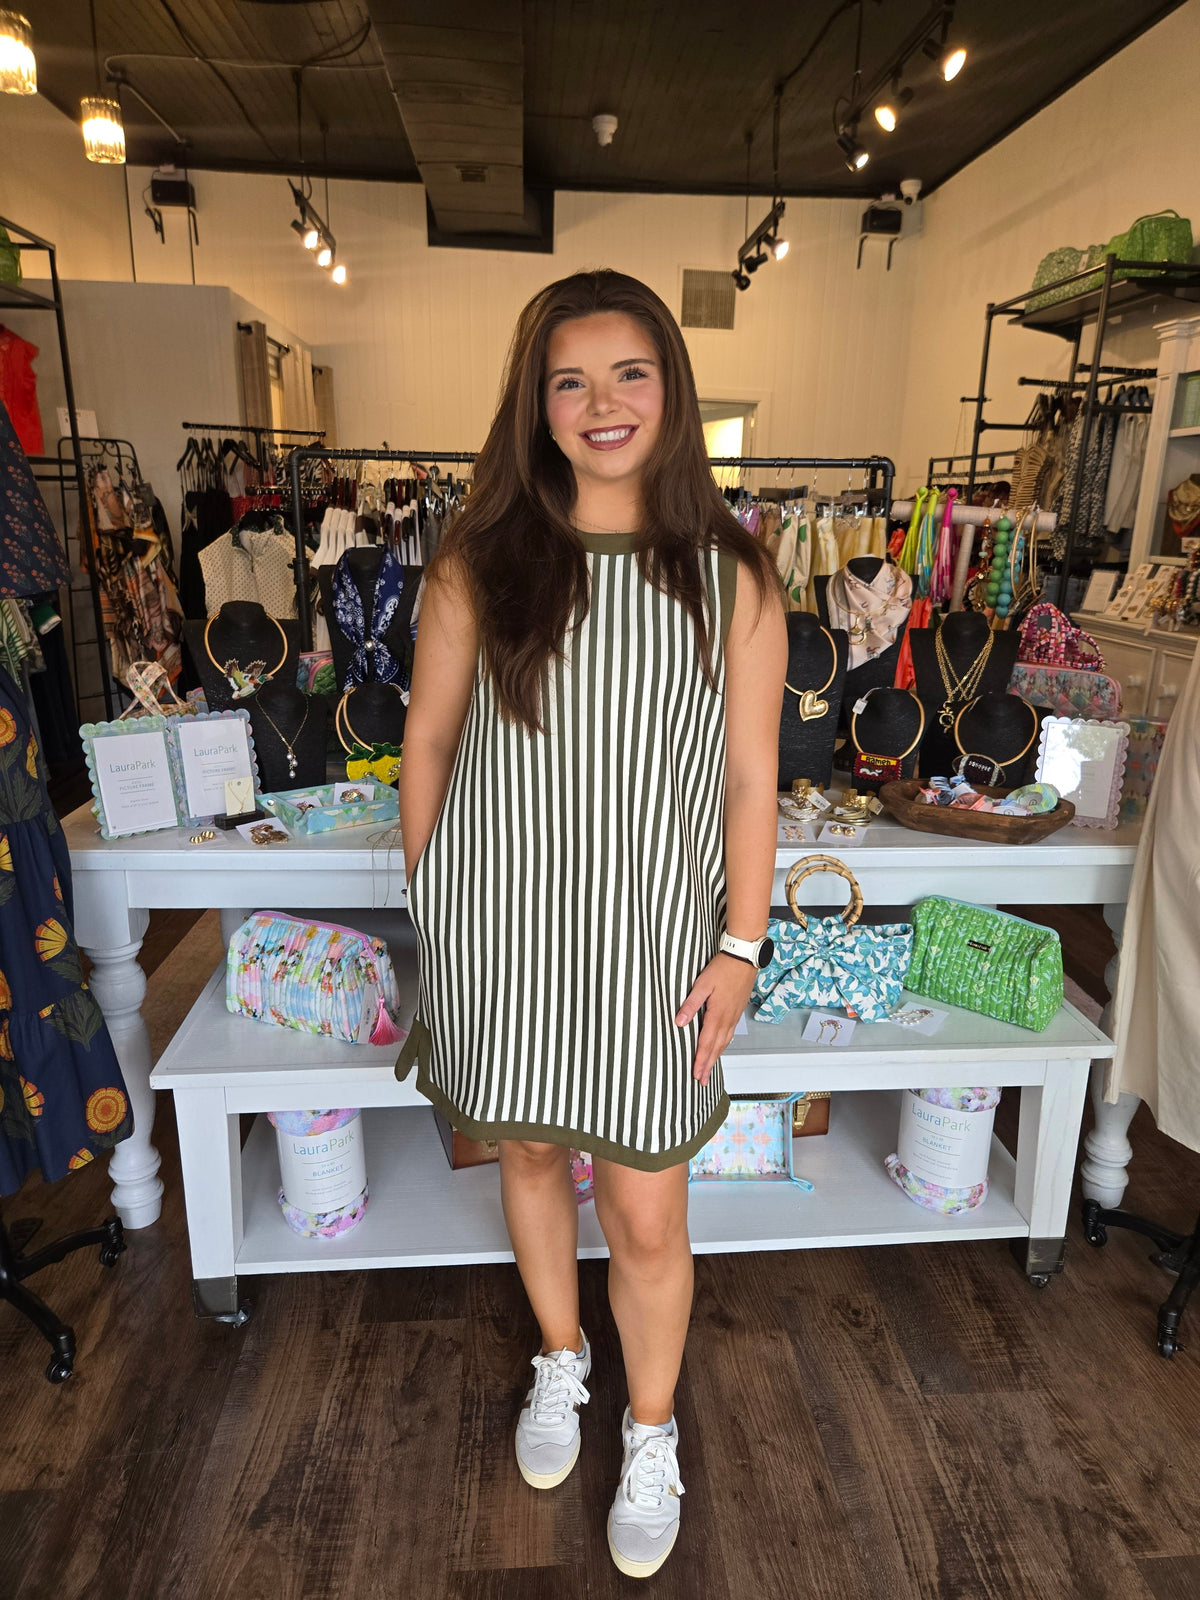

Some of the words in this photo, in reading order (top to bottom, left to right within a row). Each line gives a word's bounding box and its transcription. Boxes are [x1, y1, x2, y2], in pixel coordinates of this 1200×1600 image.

[193, 744, 238, 757] LauraPark
[109, 760, 156, 773] LauraPark
[911, 1102, 971, 1132] LauraPark
[293, 1130, 354, 1155] LauraPark
[922, 1136, 952, 1150] BLANKET
[312, 1163, 344, 1177] BLANKET
